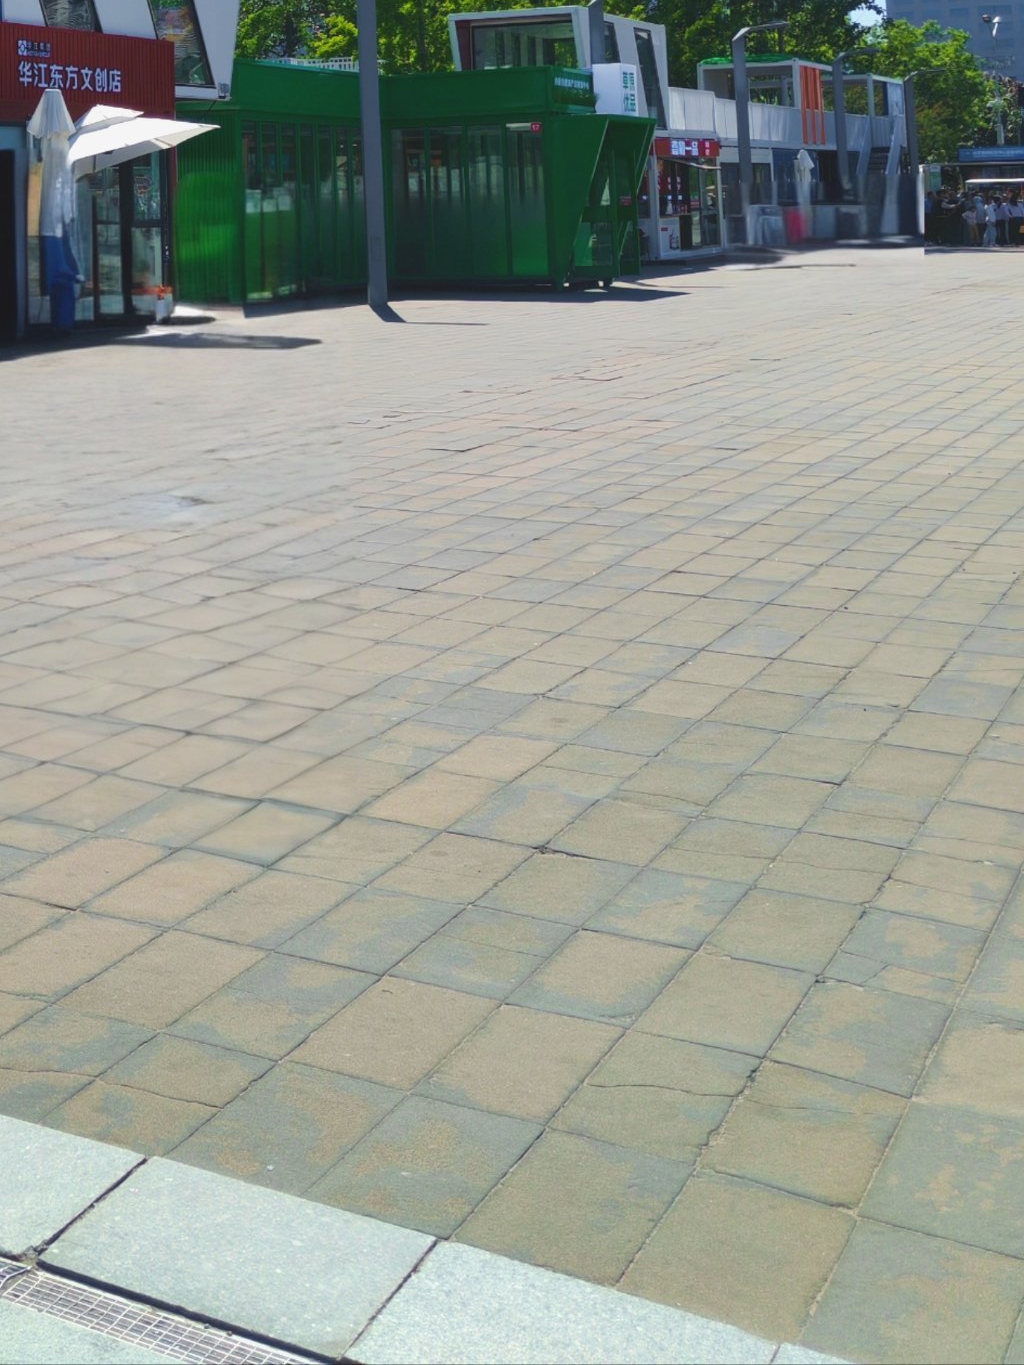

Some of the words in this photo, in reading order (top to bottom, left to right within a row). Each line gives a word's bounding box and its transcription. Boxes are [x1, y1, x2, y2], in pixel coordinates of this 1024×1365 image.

[18, 60, 122, 93] 华江东方文创店
